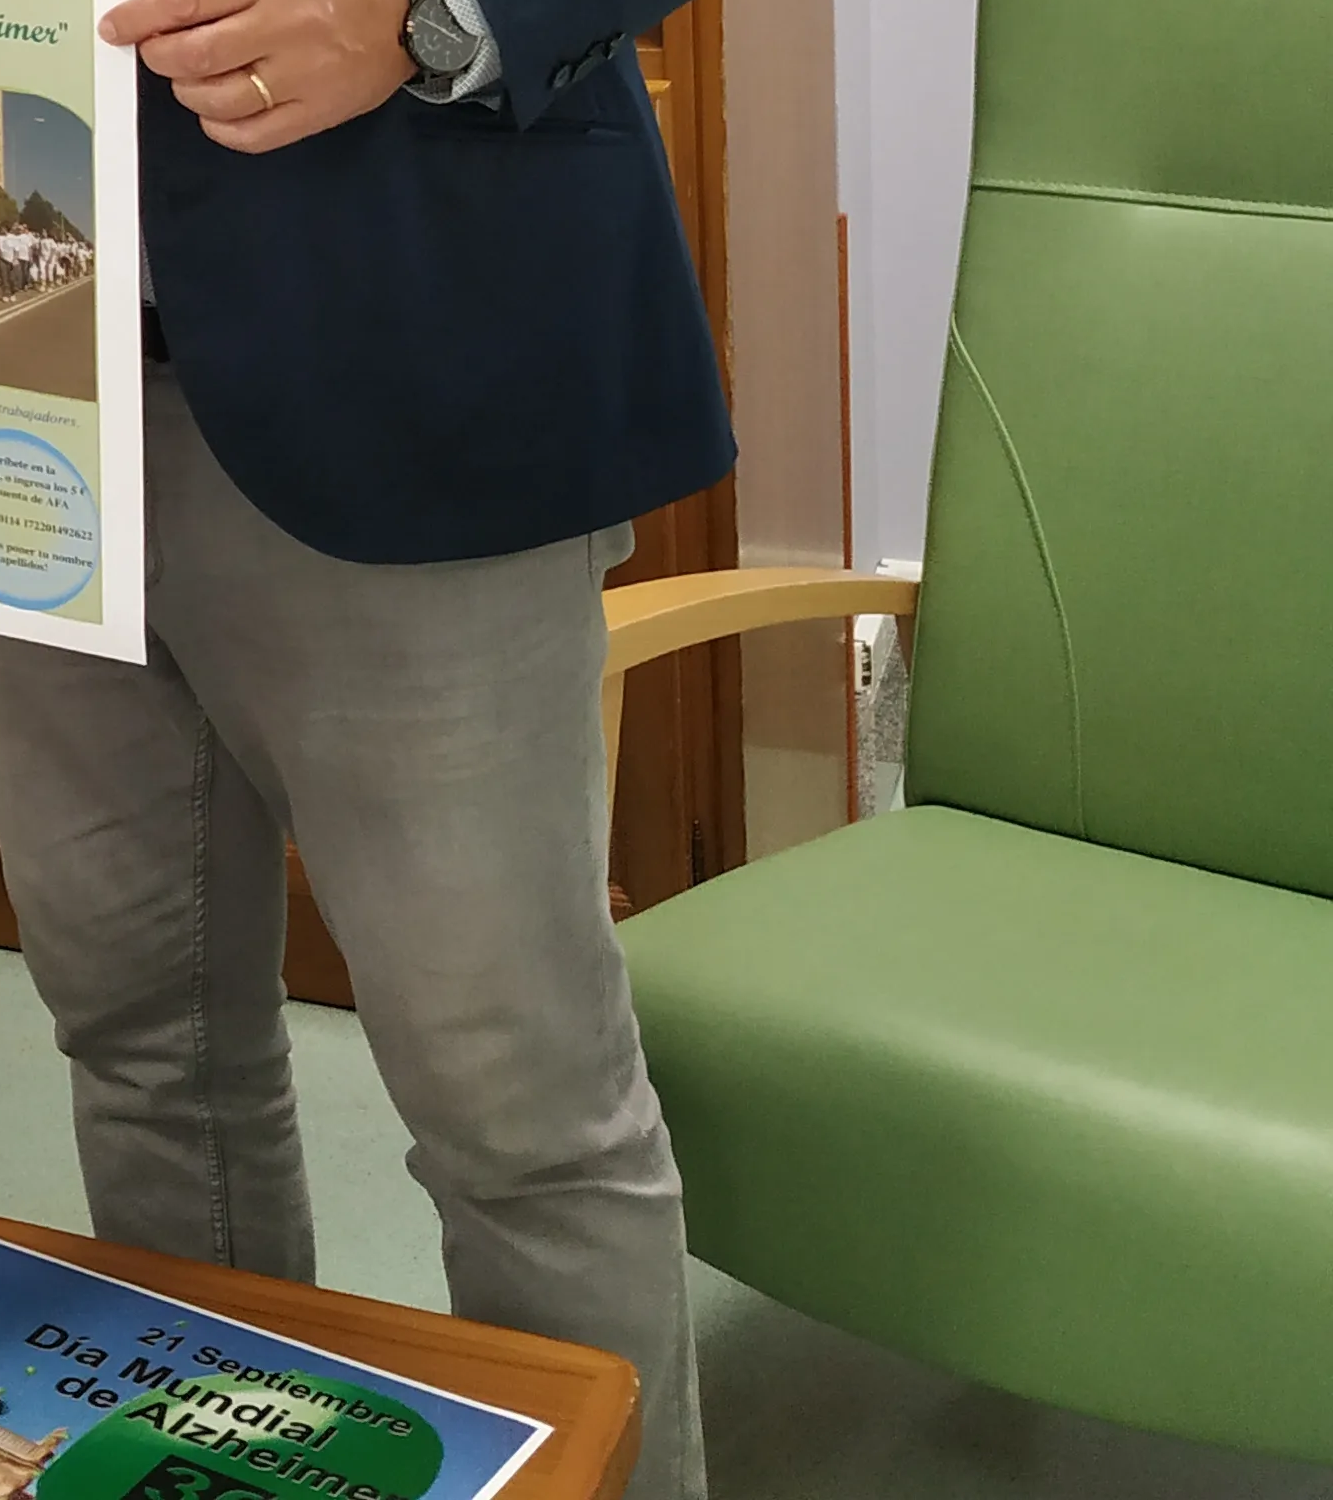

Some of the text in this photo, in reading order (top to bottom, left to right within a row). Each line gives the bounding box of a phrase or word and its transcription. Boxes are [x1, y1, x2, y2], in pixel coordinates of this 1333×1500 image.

[31, 464, 43, 473] en
[46, 465, 56, 476] la
[14, 475, 51, 492] ingresa
[53, 482, 68, 494] los
[71, 484, 78, 496] 5
[30, 493, 43, 504] de
[45, 496, 70, 510] AFA
[6, 543, 35, 557] poner
[52, 551, 93, 568] nombre
[24, 1323, 339, 1452] Día Mundial
[137, 1326, 413, 1437] 21 Septiembre
[54, 1375, 408, 1500] de Alzheime
